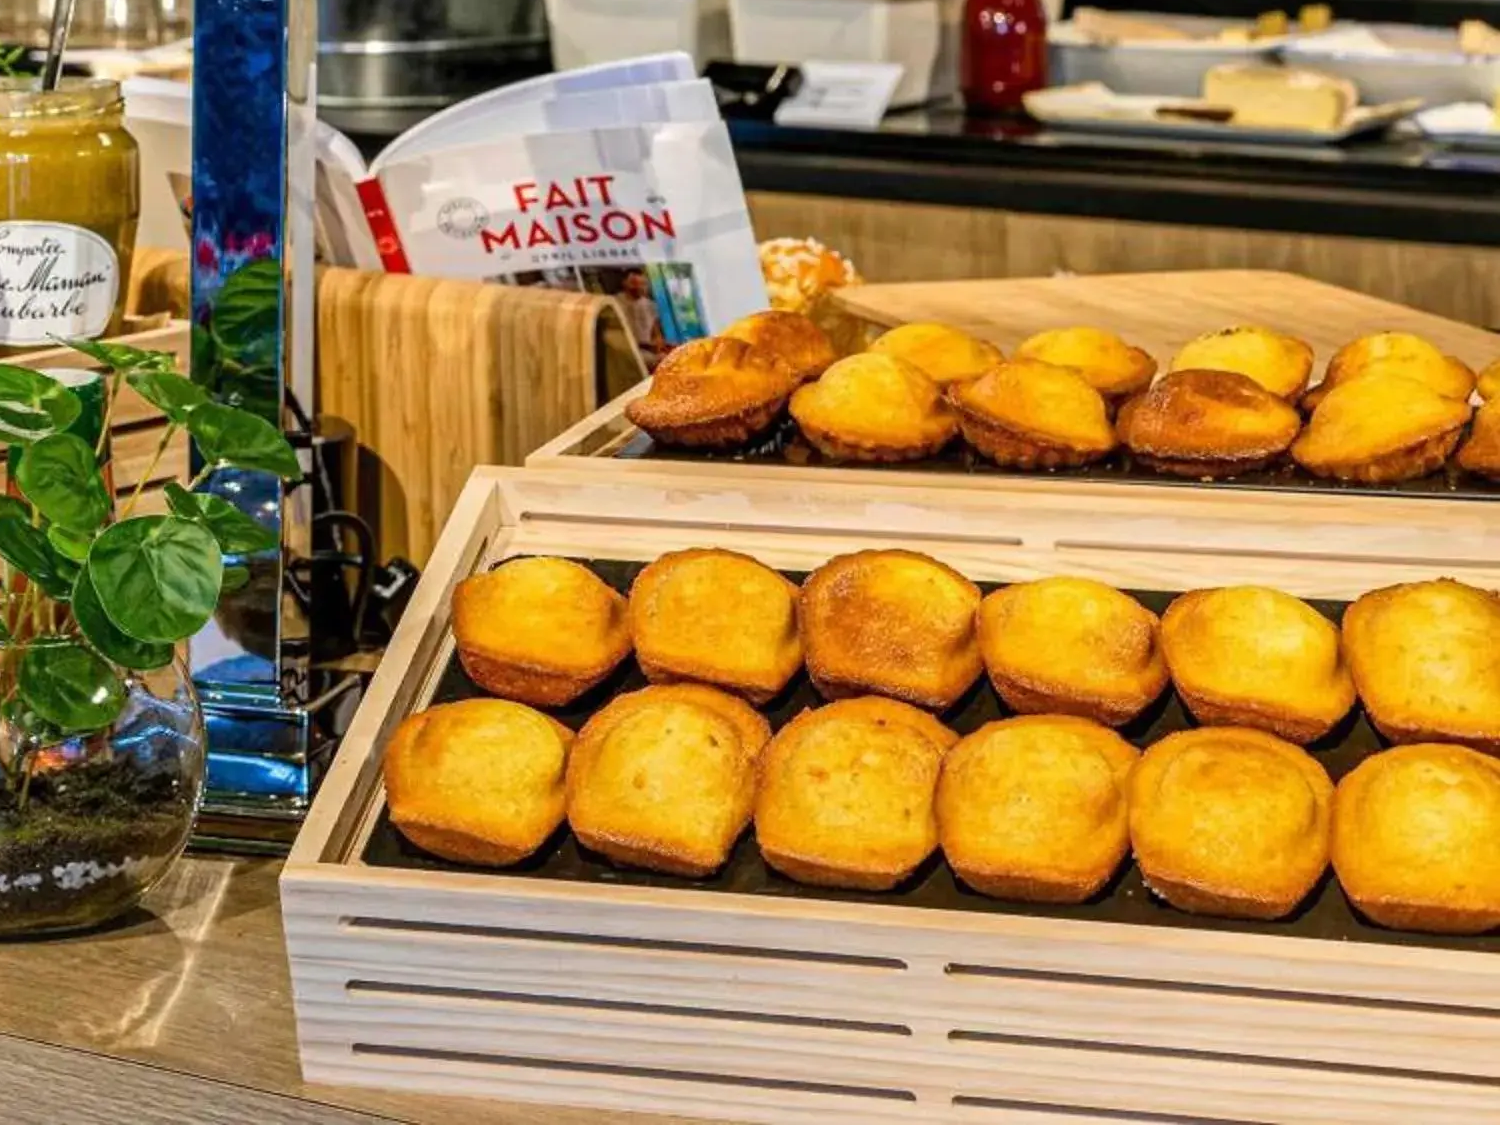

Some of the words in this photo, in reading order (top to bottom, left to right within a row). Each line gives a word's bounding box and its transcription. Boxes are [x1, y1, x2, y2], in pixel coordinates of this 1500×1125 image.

[513, 175, 615, 214] FAIT
[480, 209, 677, 254] MAISON
[16, 256, 110, 293] Maman
